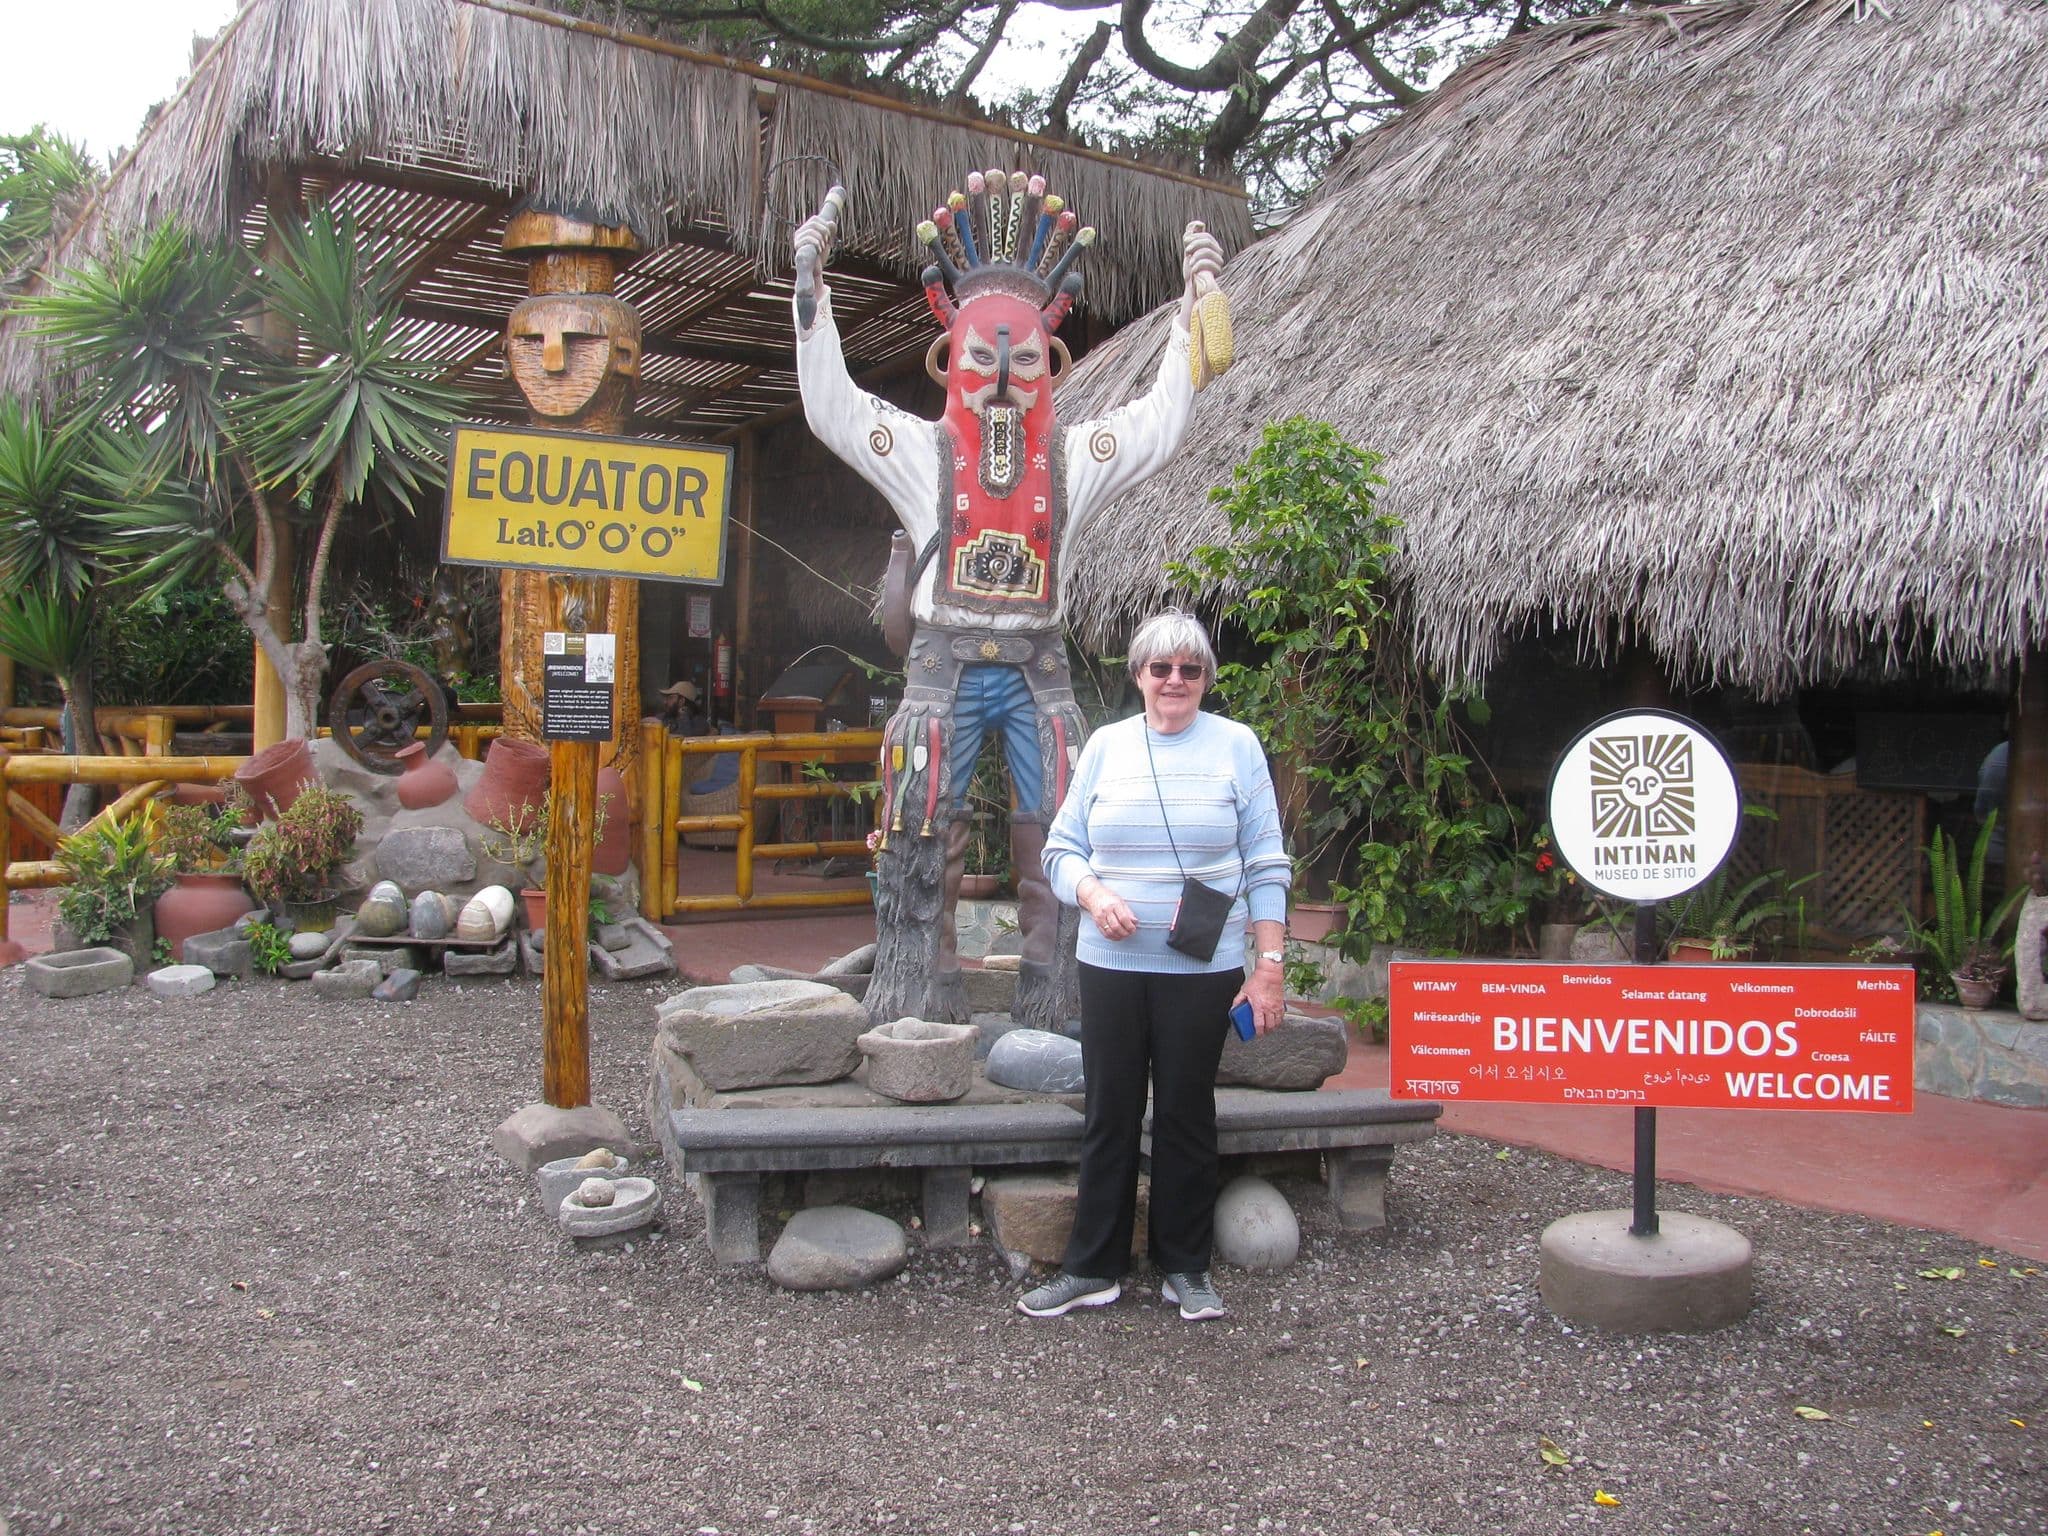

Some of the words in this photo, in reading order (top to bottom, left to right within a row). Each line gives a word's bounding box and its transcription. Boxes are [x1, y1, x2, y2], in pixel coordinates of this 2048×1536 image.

[467, 448, 709, 518] EQUATOR
[1595, 839, 1695, 865] INTIÑAN
[1596, 869, 1637, 880] MUSEO
[1644, 869, 1659, 879] DE
[1664, 867, 1695, 878] SITIO
[1563, 975, 1611, 984] Benvidos
[1857, 980, 1900, 990] Merhba
[1413, 982, 1457, 991] WITAMY
[1482, 984, 1546, 994] BEM-VINDA
[1730, 983, 1793, 993] Velkommen
[1622, 989, 1664, 999] Selamat
[1668, 990, 1707, 1002] datang
[1414, 1012, 1481, 1024] Mirëseardhje
[1795, 1008, 1856, 1018] Dobrodošli
[1494, 1017, 1798, 1056] BIENVENIDOS
[1860, 1029, 1896, 1042] FÁILTE
[1811, 1051, 1849, 1061] Croesa
[1469, 1064, 1499, 1080] 어서
[1504, 1066, 1566, 1080] 오십시오
[1725, 1072, 1890, 1100] WELCOME
